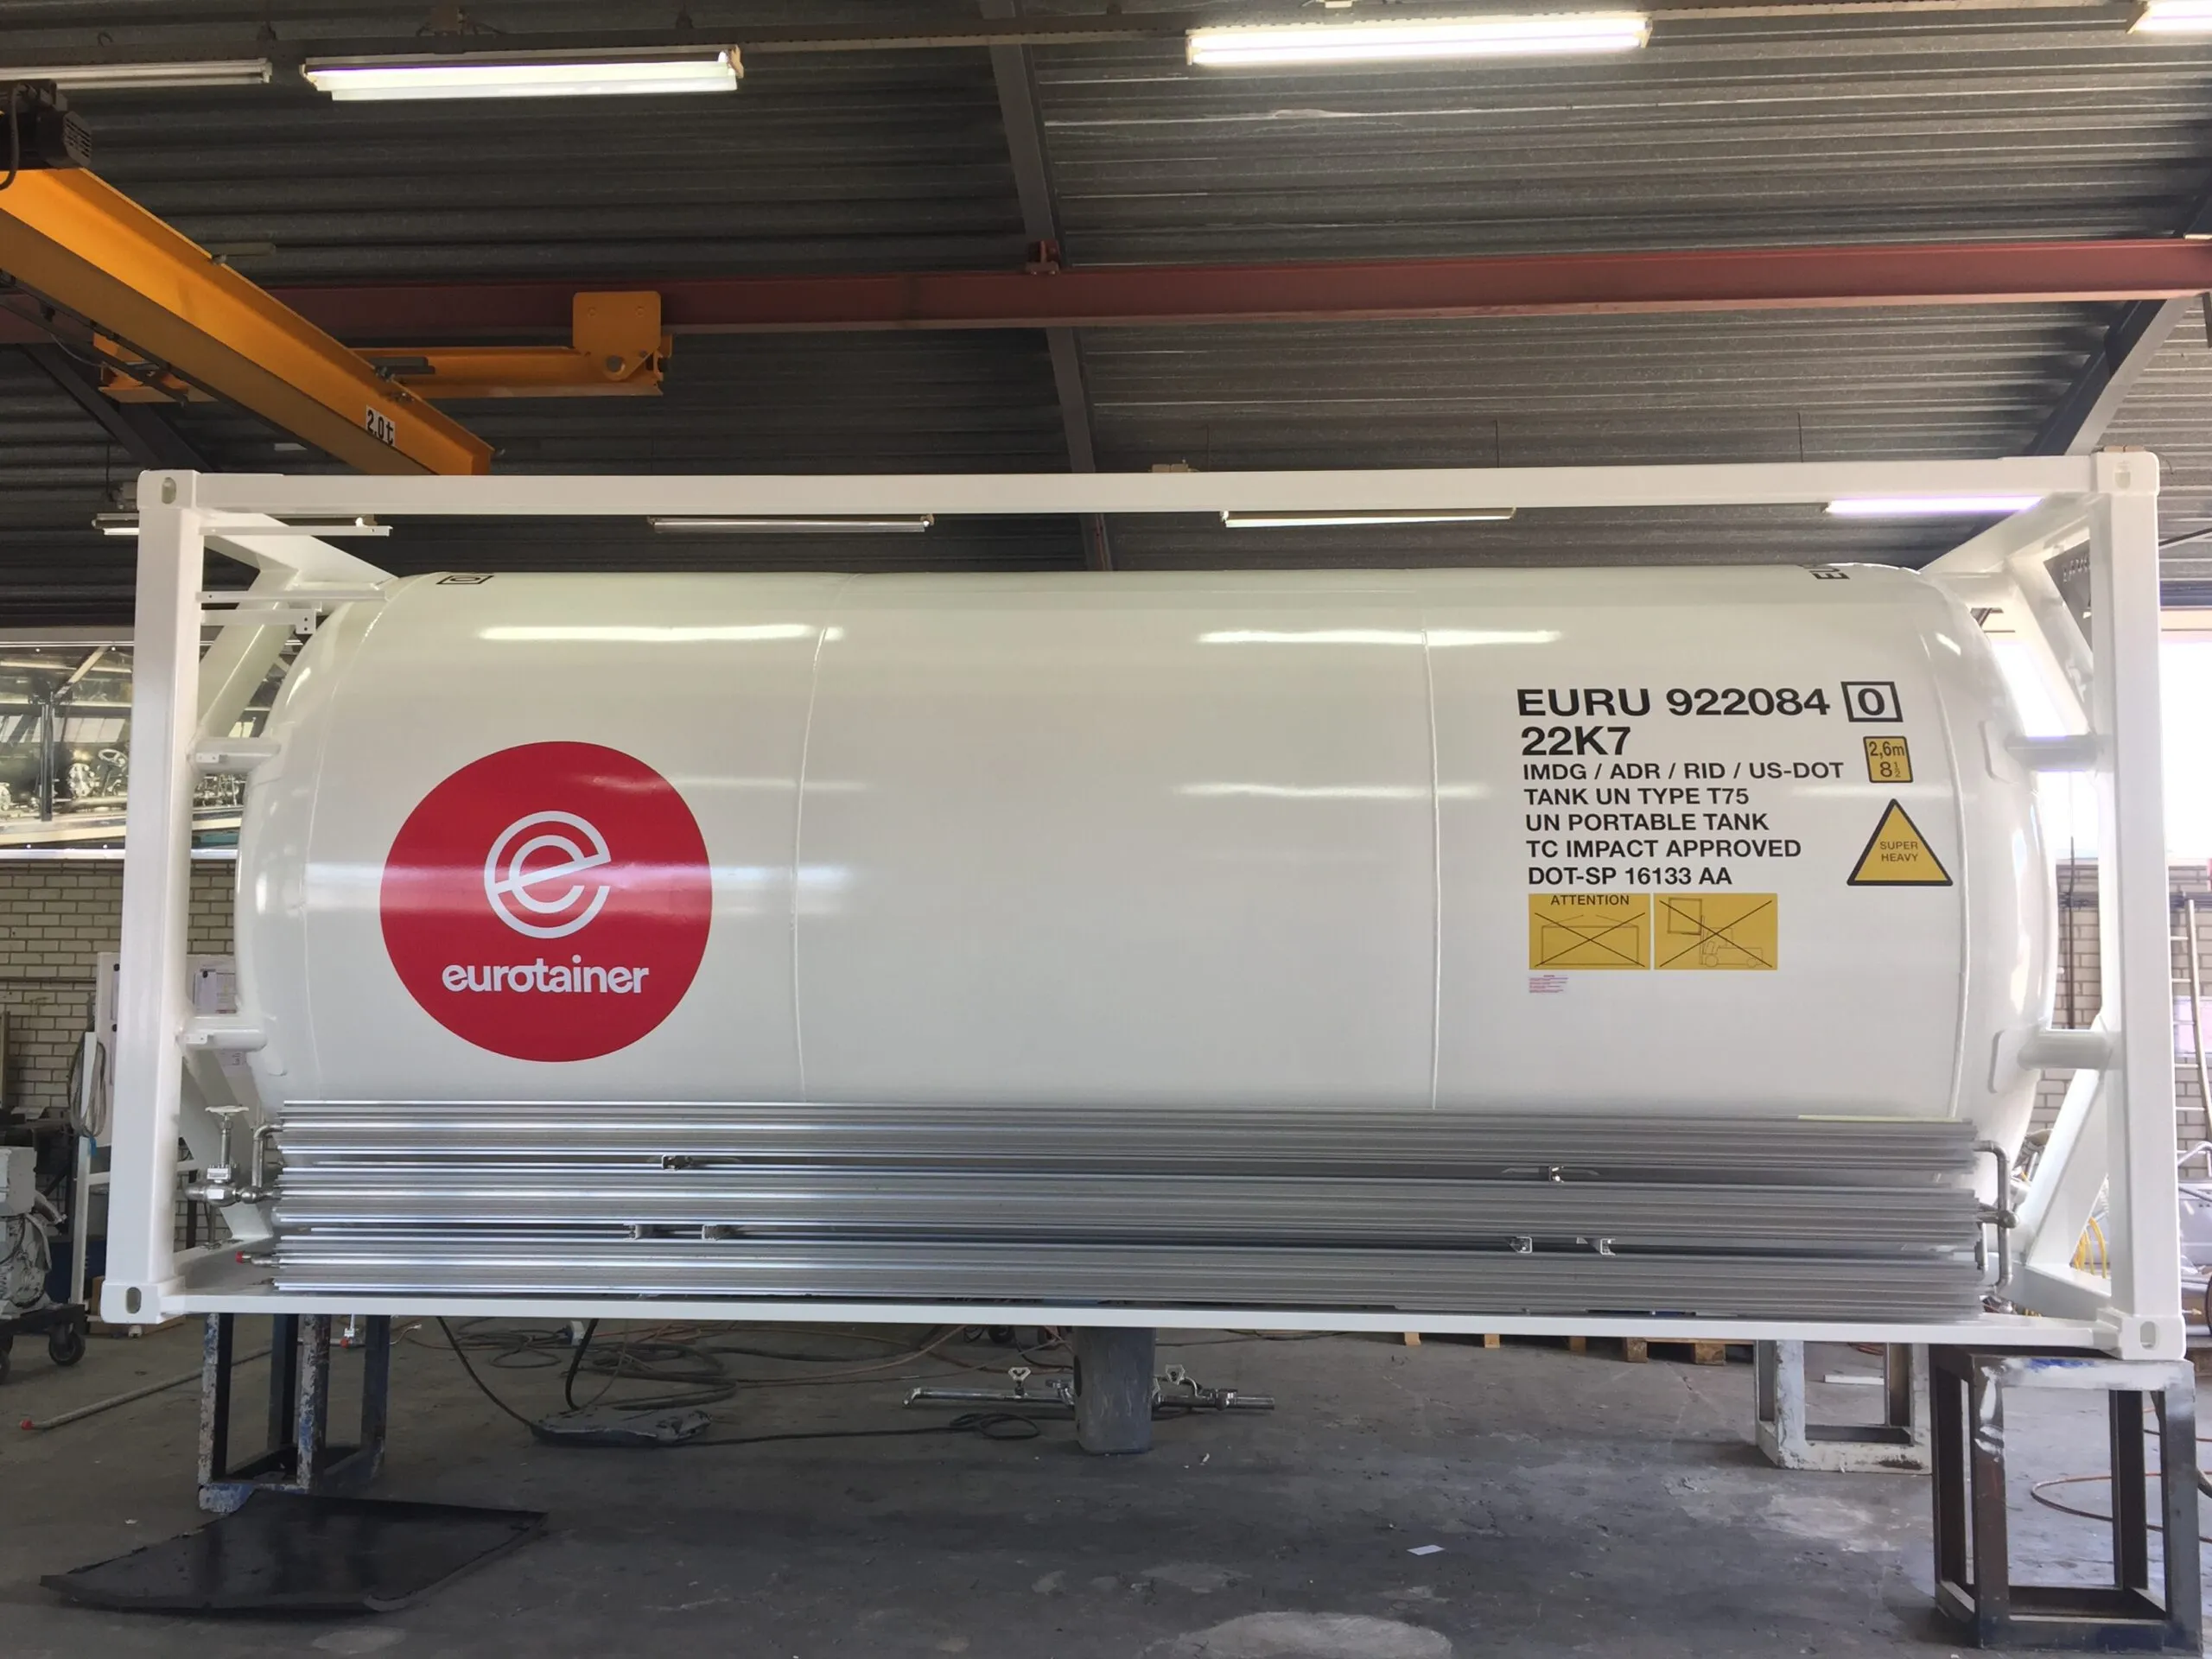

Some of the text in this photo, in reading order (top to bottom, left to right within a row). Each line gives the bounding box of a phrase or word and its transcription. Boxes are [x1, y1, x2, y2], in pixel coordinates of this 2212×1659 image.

[1516, 688, 1885, 717] EURU 922084 0
[1521, 726, 1631, 756] 22K7
[1868, 741, 1905, 759] 2,6m
[1522, 763, 1587, 781] IMDG
[1609, 763, 1661, 780] ADR
[1683, 762, 1726, 780] RID
[1749, 761, 1845, 780] US-DOT
[1523, 787, 1750, 806] TANK UN TYPE T75
[1525, 812, 1770, 832] UN PORTABLE TANK
[1525, 839, 1802, 858] TC IMPACT APPROVED
[1879, 841, 1919, 850] SUPER
[1880, 853, 1919, 862] HEAVY
[1528, 866, 1733, 886] DOT-SP 16133 AA
[1550, 893, 1630, 906] ATTENTION
[442, 954, 650, 994] eurotainer
